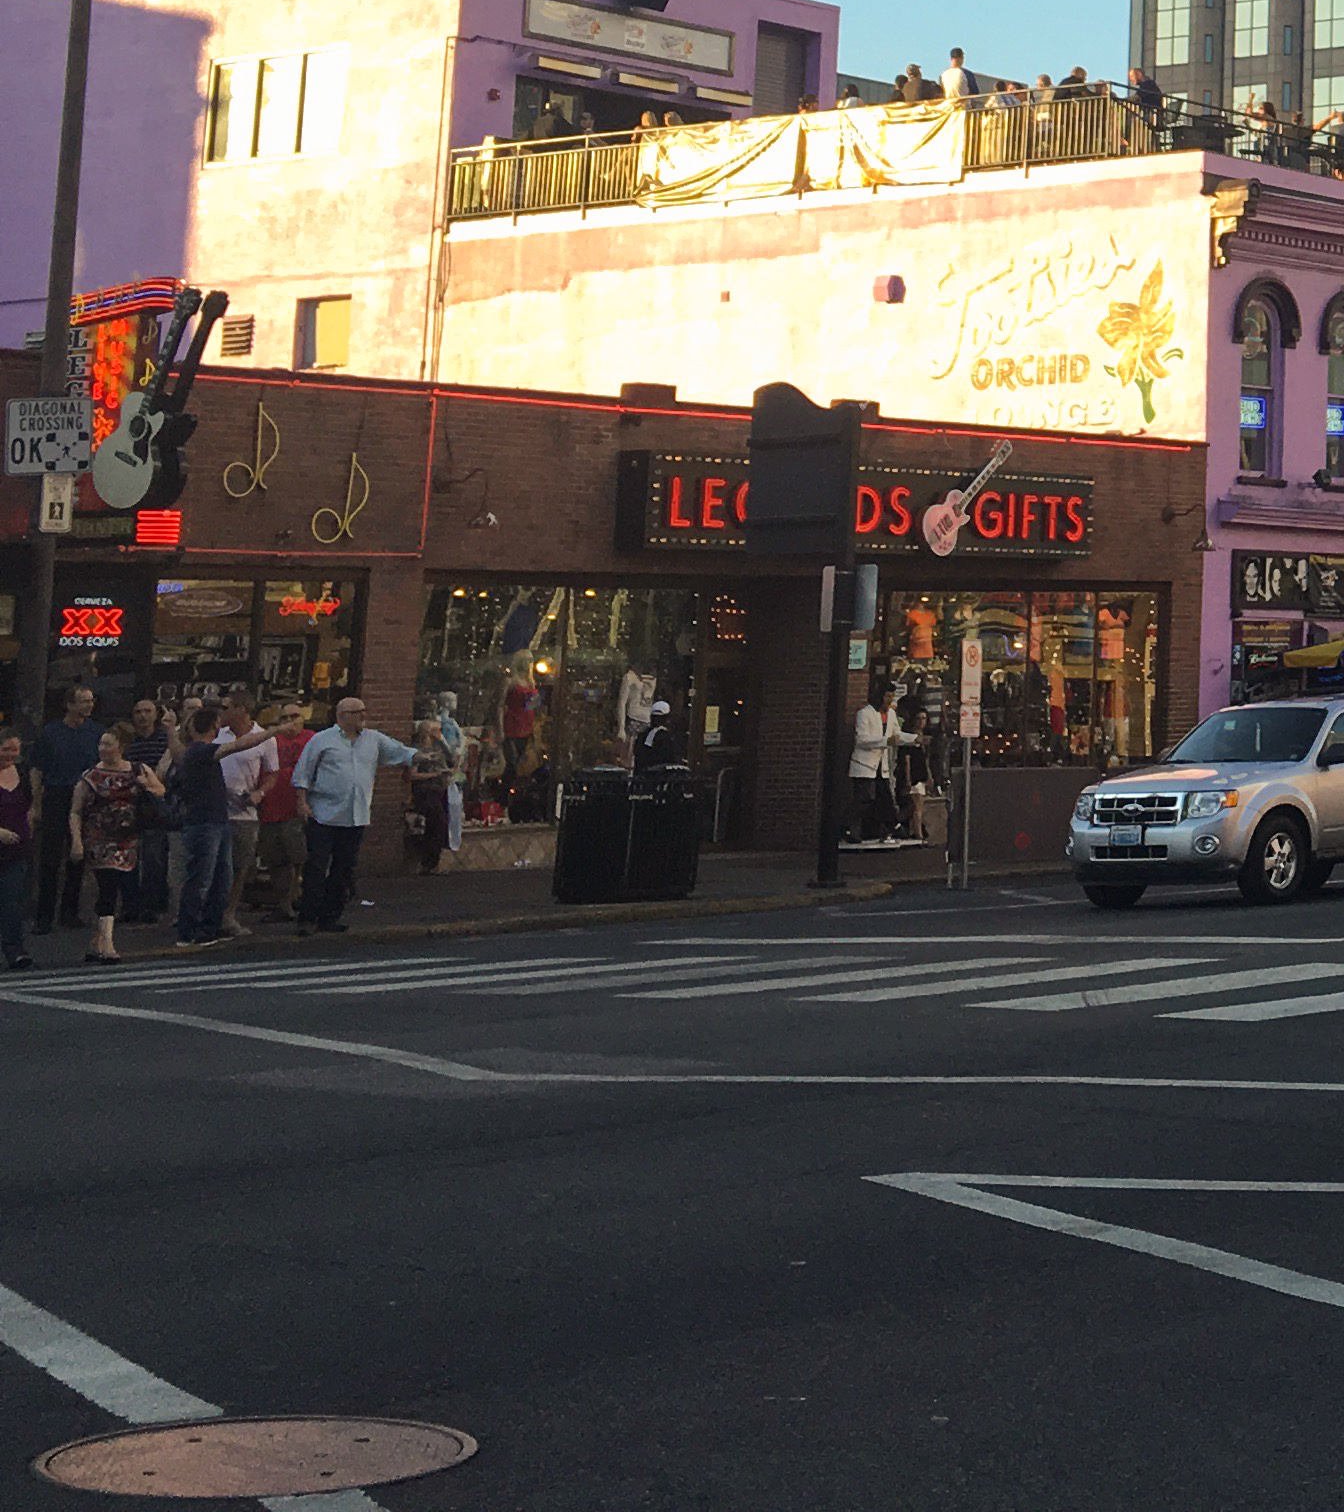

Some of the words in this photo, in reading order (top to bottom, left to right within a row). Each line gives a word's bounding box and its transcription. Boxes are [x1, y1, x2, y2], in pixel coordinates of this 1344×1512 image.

[970, 354, 1091, 392] ORCHID
[18, 402, 85, 416] DIAGONAL
[19, 416, 84, 432] CROSSING
[10, 437, 43, 465] OK
[668, 475, 912, 536] LEDS
[973, 490, 1086, 543] GIFTS
[60, 608, 124, 636] XX
[59, 636, 84, 647] DOS
[86, 636, 120, 648] EQUIS
